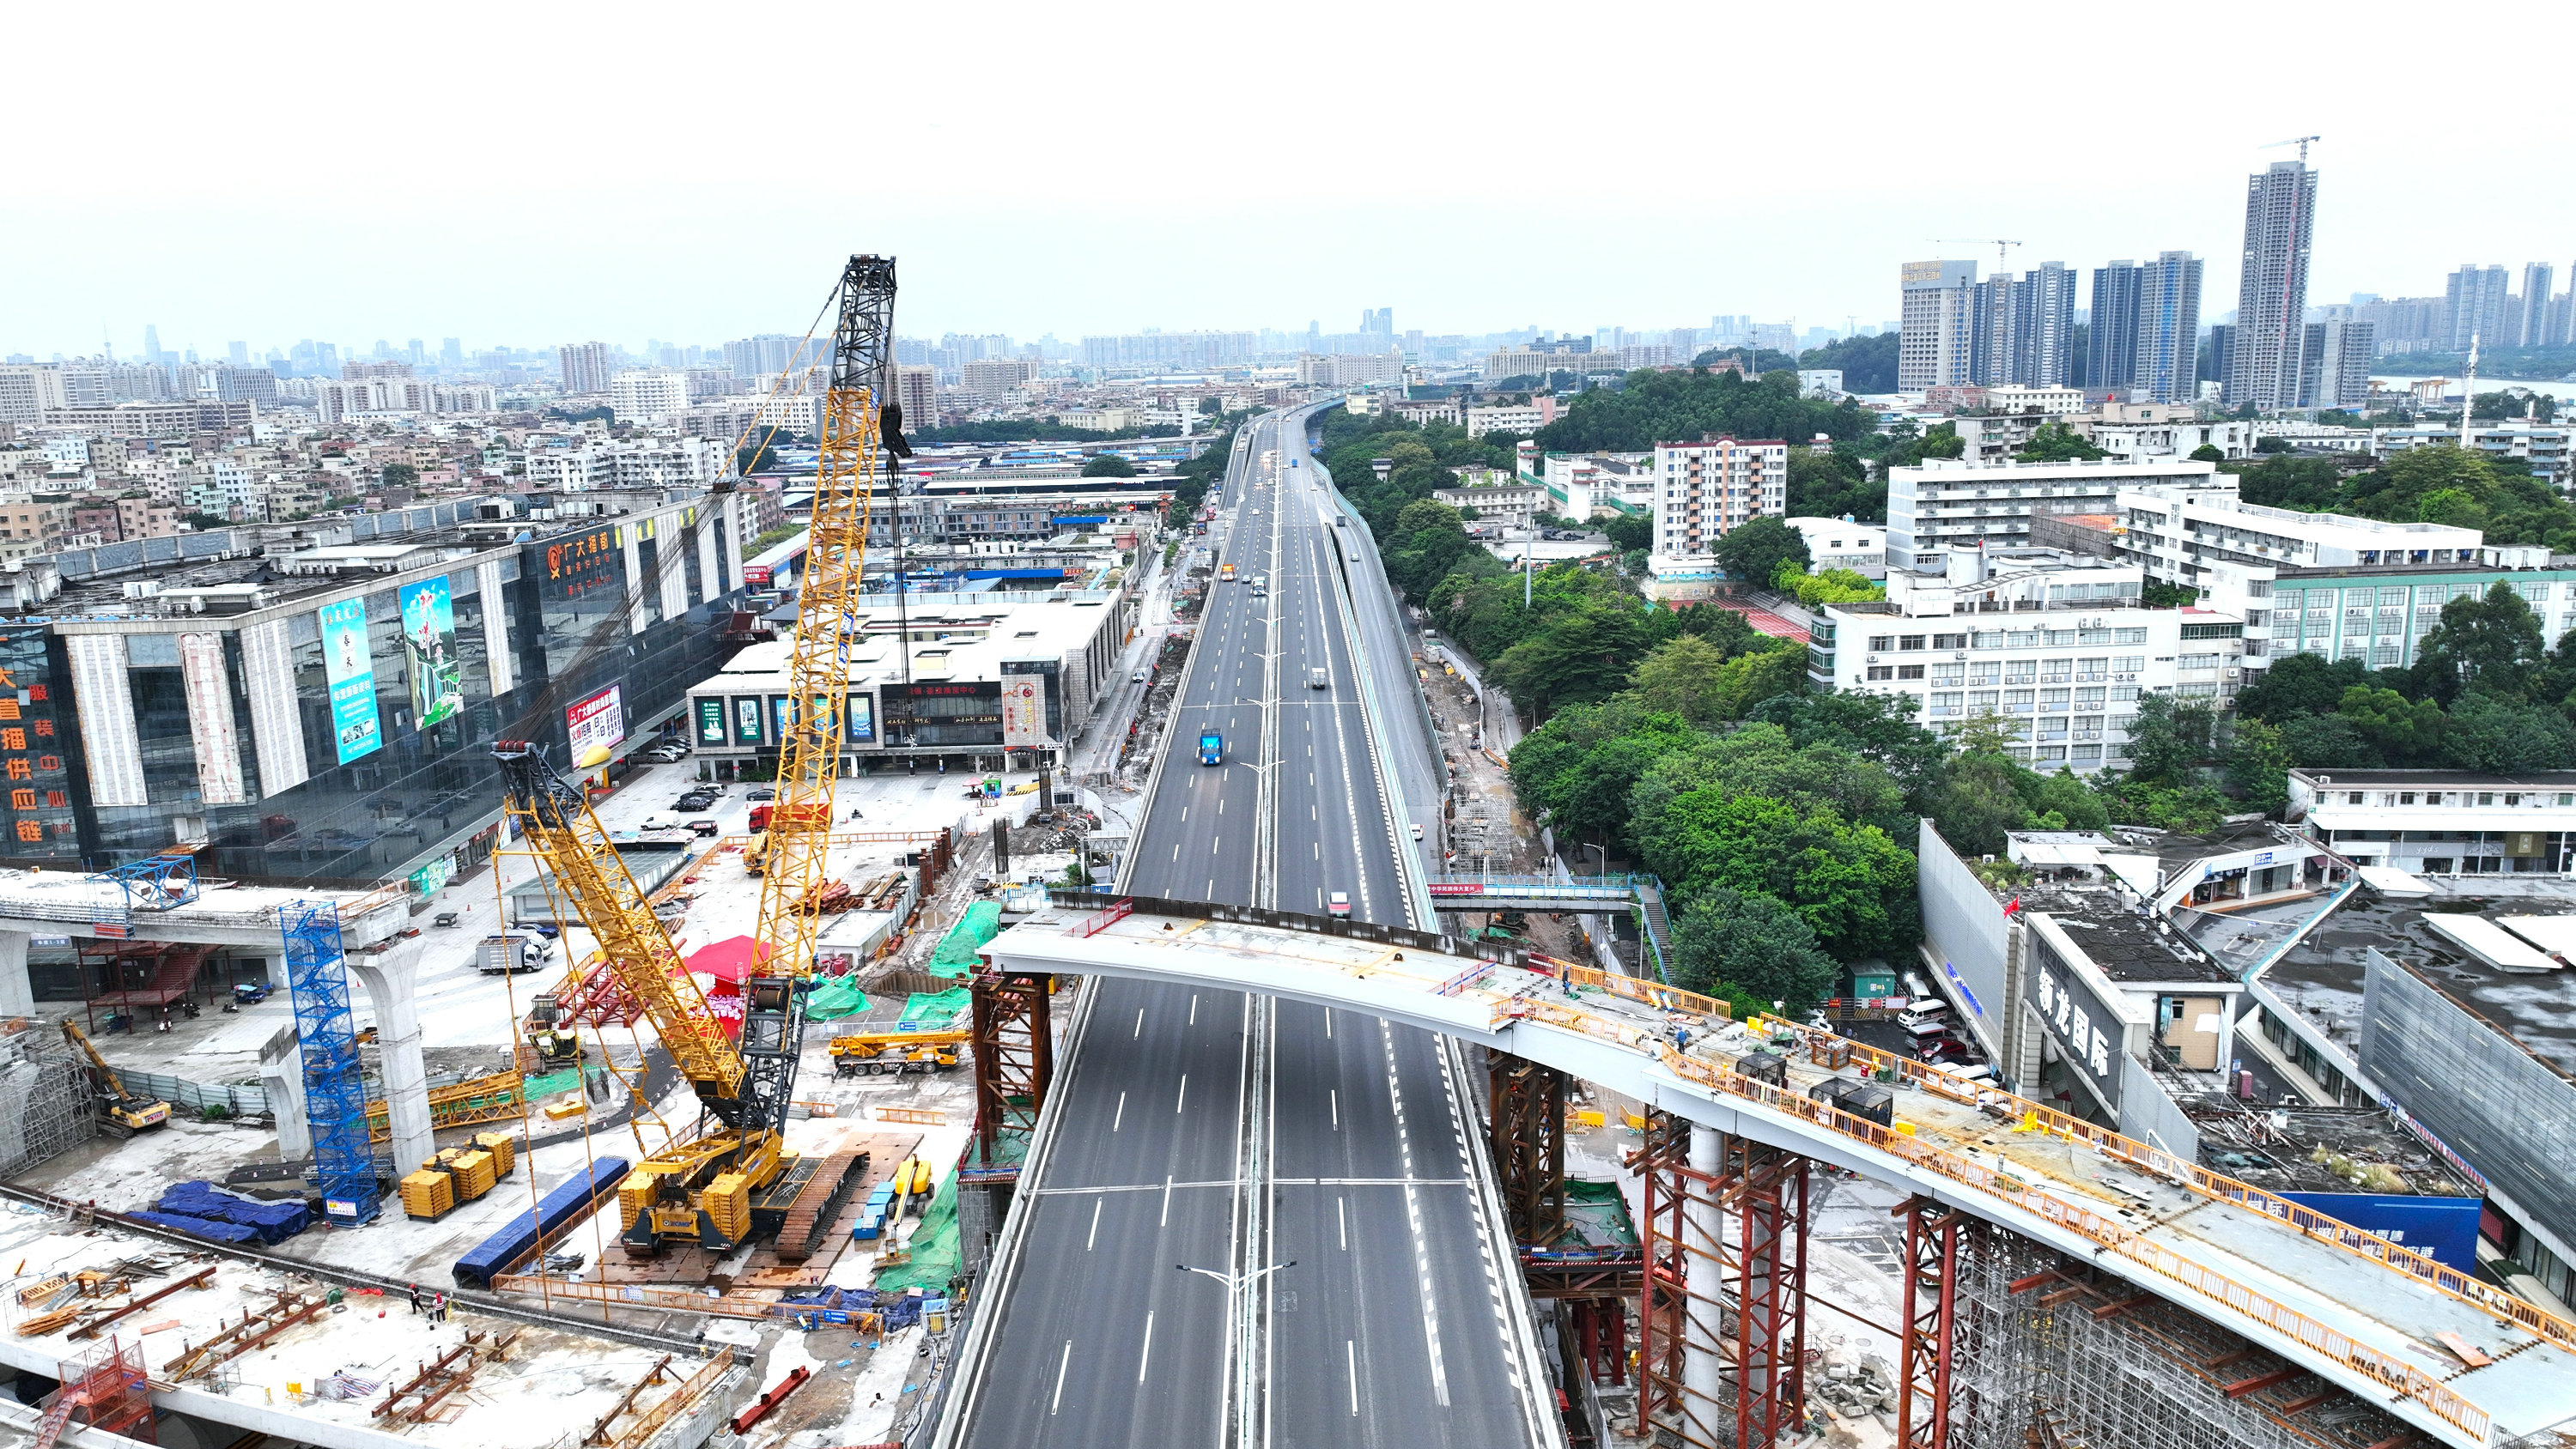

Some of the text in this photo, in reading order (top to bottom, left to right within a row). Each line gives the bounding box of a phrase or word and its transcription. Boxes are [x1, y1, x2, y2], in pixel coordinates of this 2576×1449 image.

[0, 637, 42, 842] 大直播供应链
[28, 684, 67, 808] 服装中心
[2038, 966, 2109, 1076] 领龙国际
